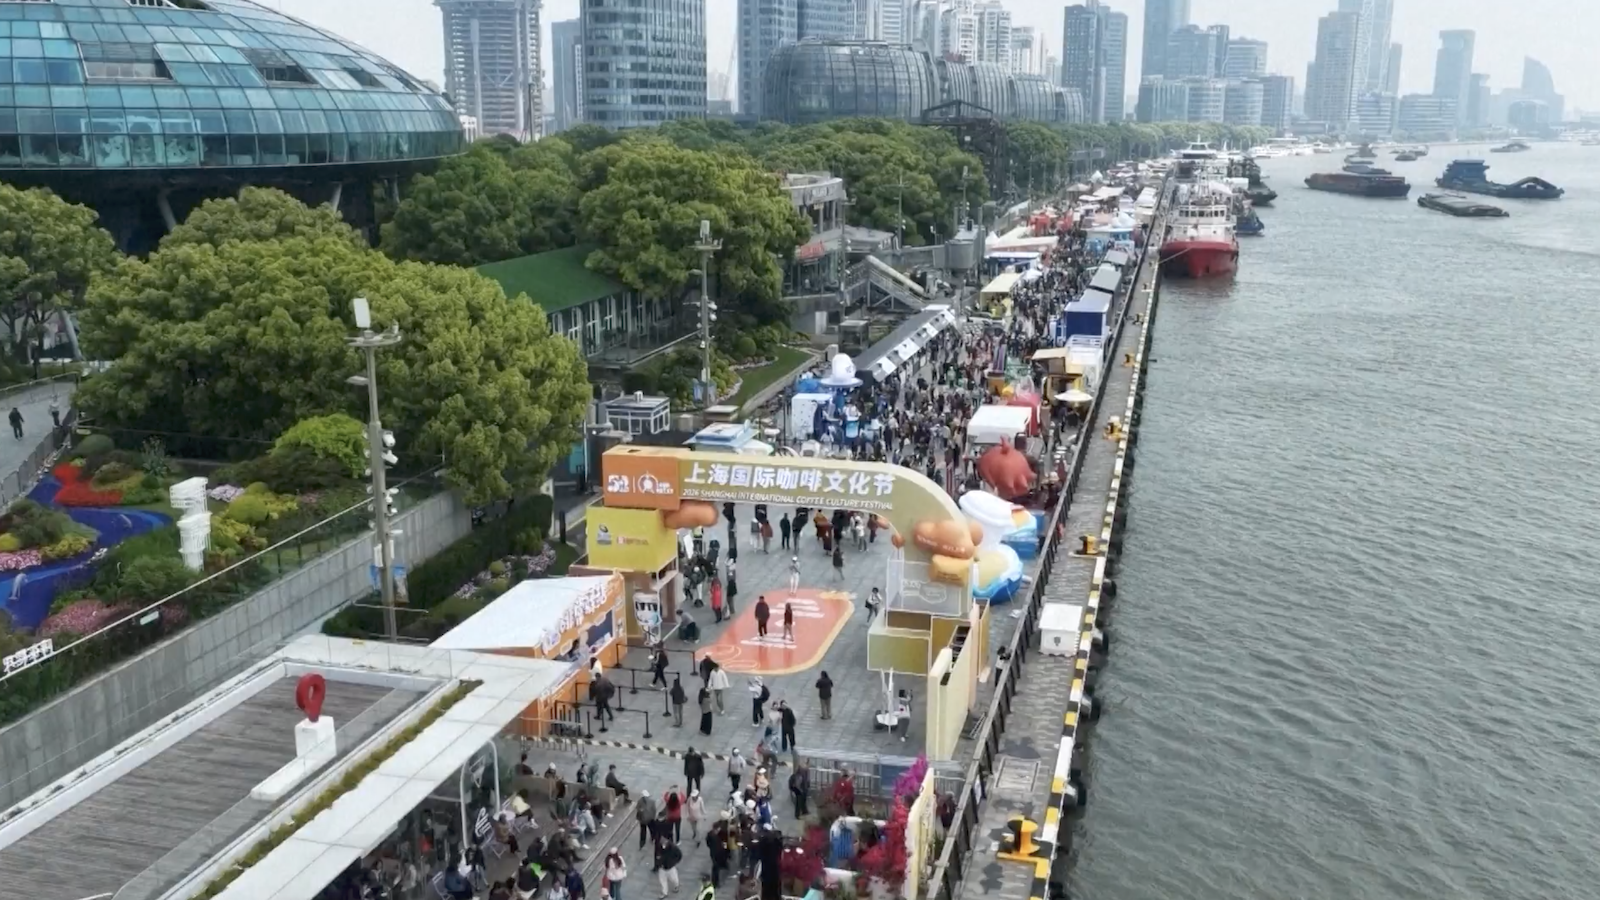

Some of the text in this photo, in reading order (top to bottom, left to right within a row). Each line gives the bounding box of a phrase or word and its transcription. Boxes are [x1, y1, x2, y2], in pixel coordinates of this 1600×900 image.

[684, 462, 895, 496] 上海国际咖啡文化节
[682, 488, 893, 510] 2026 SHANGHAI INTERNATIONAL COFFEE CULTURE FESTIVAL
